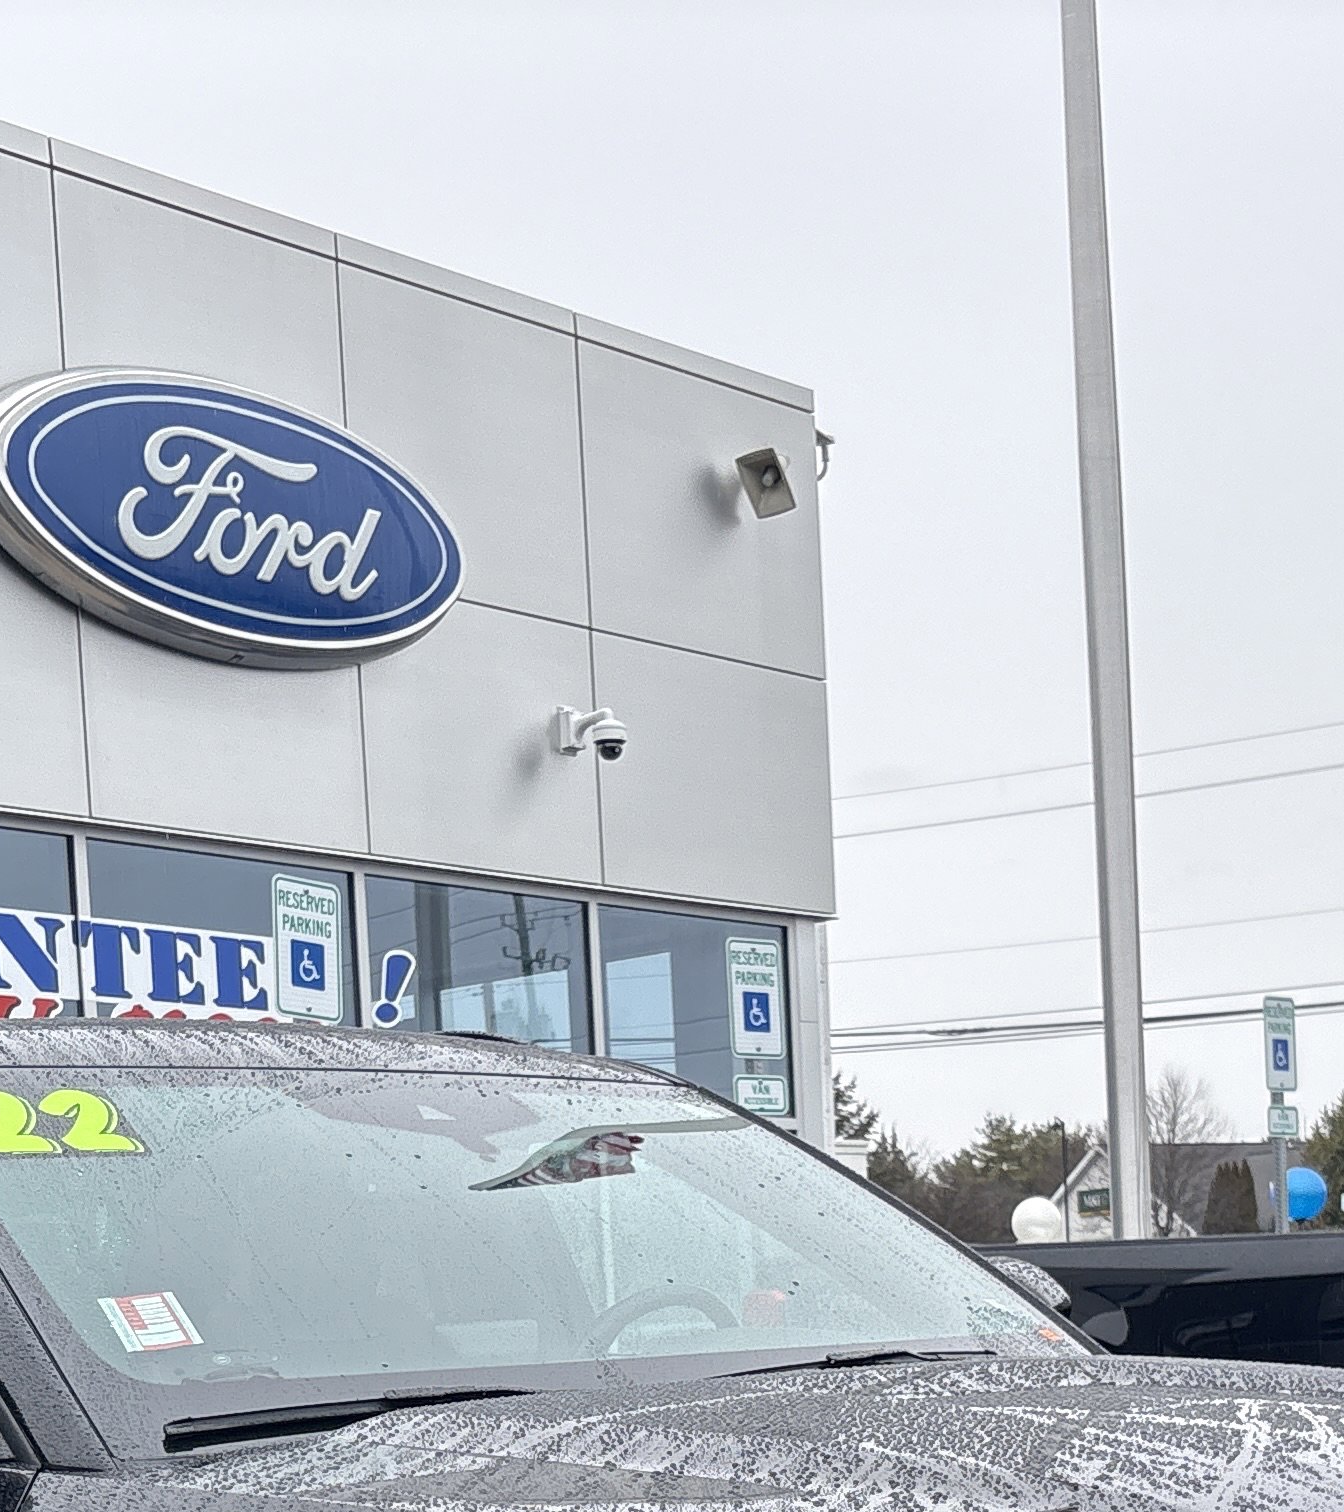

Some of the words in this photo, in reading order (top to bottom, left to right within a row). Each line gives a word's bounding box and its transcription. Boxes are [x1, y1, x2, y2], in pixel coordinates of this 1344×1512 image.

[118, 426, 382, 601] Ford
[278, 888, 335, 916] RESERVED
[282, 914, 332, 939] PARKING
[730, 950, 776, 968] RESERVED
[735, 970, 775, 988] PARKING
[751, 1083, 770, 1096] VAN
